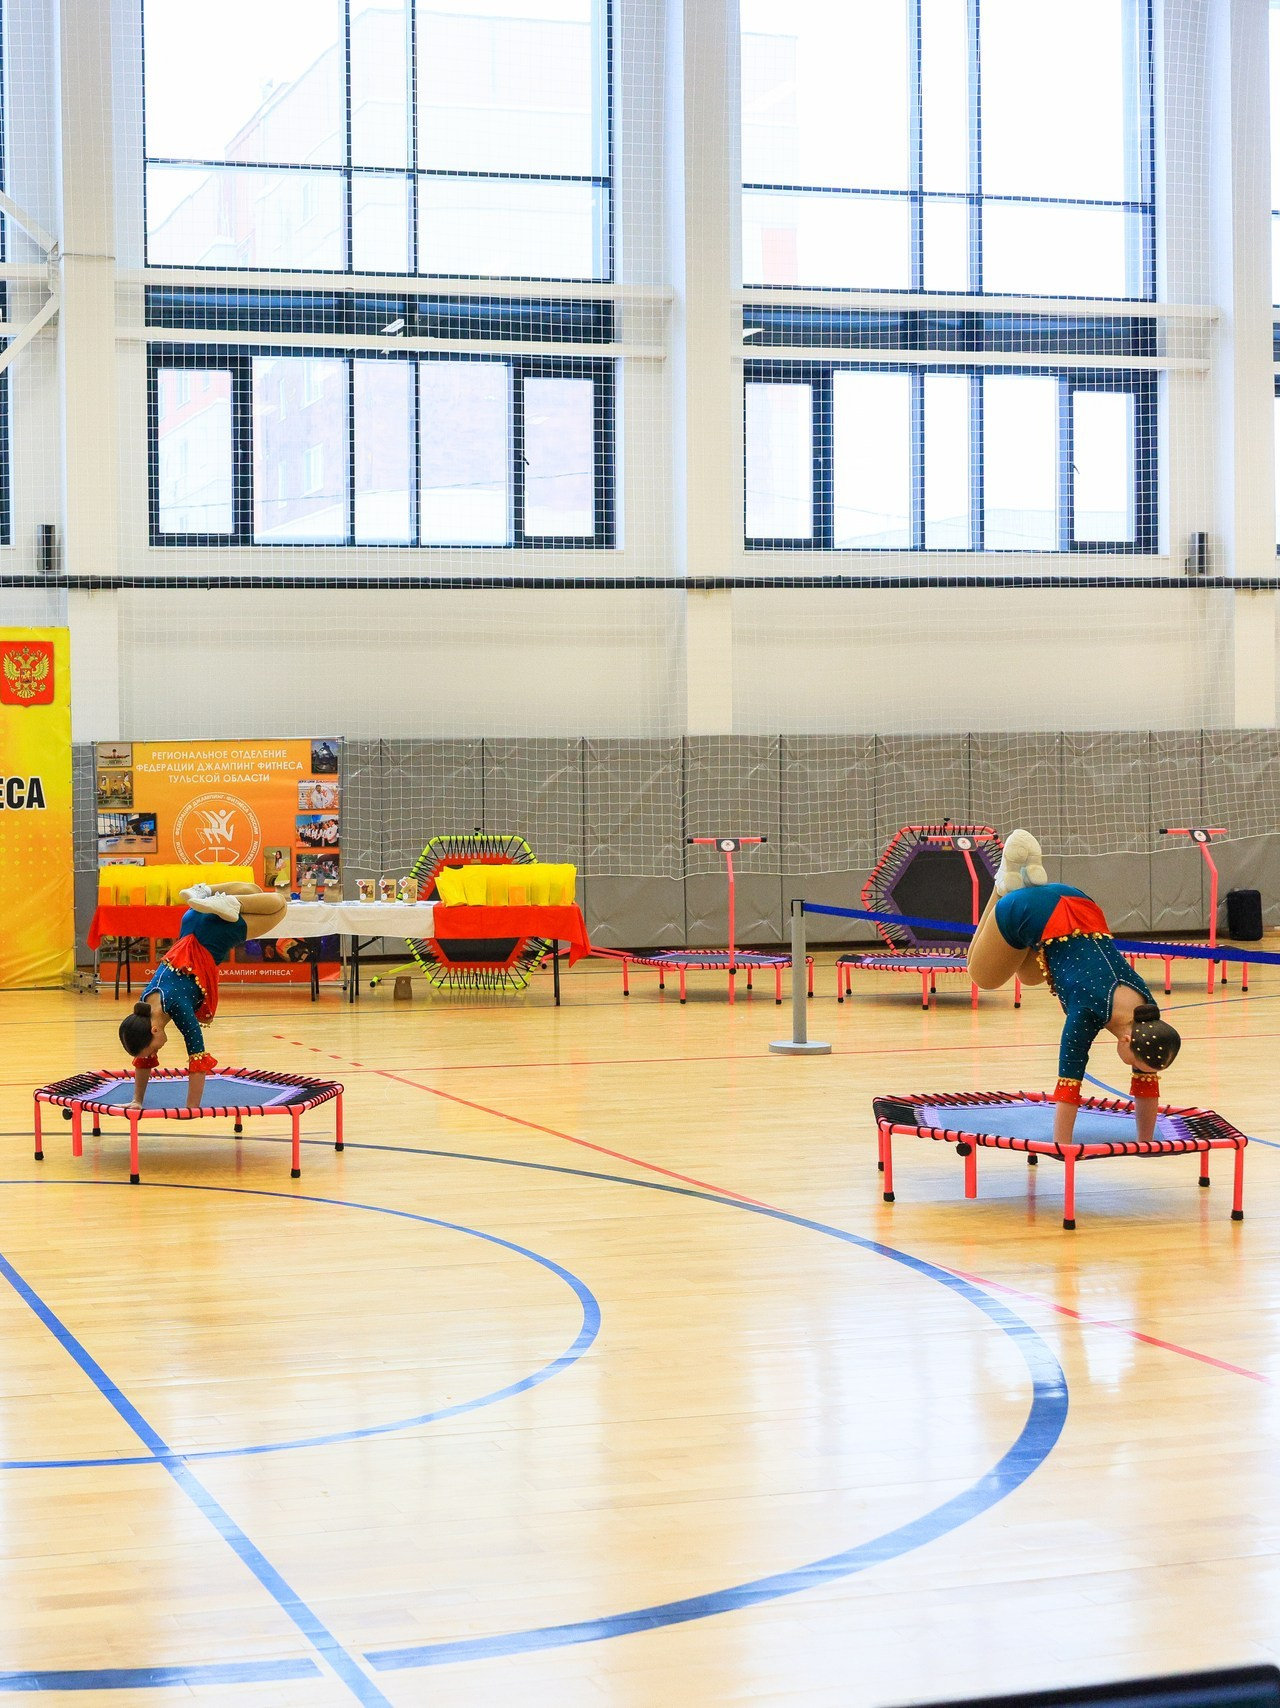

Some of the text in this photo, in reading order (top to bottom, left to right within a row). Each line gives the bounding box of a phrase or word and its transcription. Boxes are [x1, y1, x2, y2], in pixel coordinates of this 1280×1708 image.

[151, 749, 288, 761] РЕГИОНАЛЬНОЕ ОТДЕЛЕНИЕ
[136, 761, 304, 773] ФЕДЕРАЦИИ ДЖАМПИНГ ФИТНЕСА
[168, 772, 270, 784] ТУЛЬСКОЙ ОБЛАСТИ
